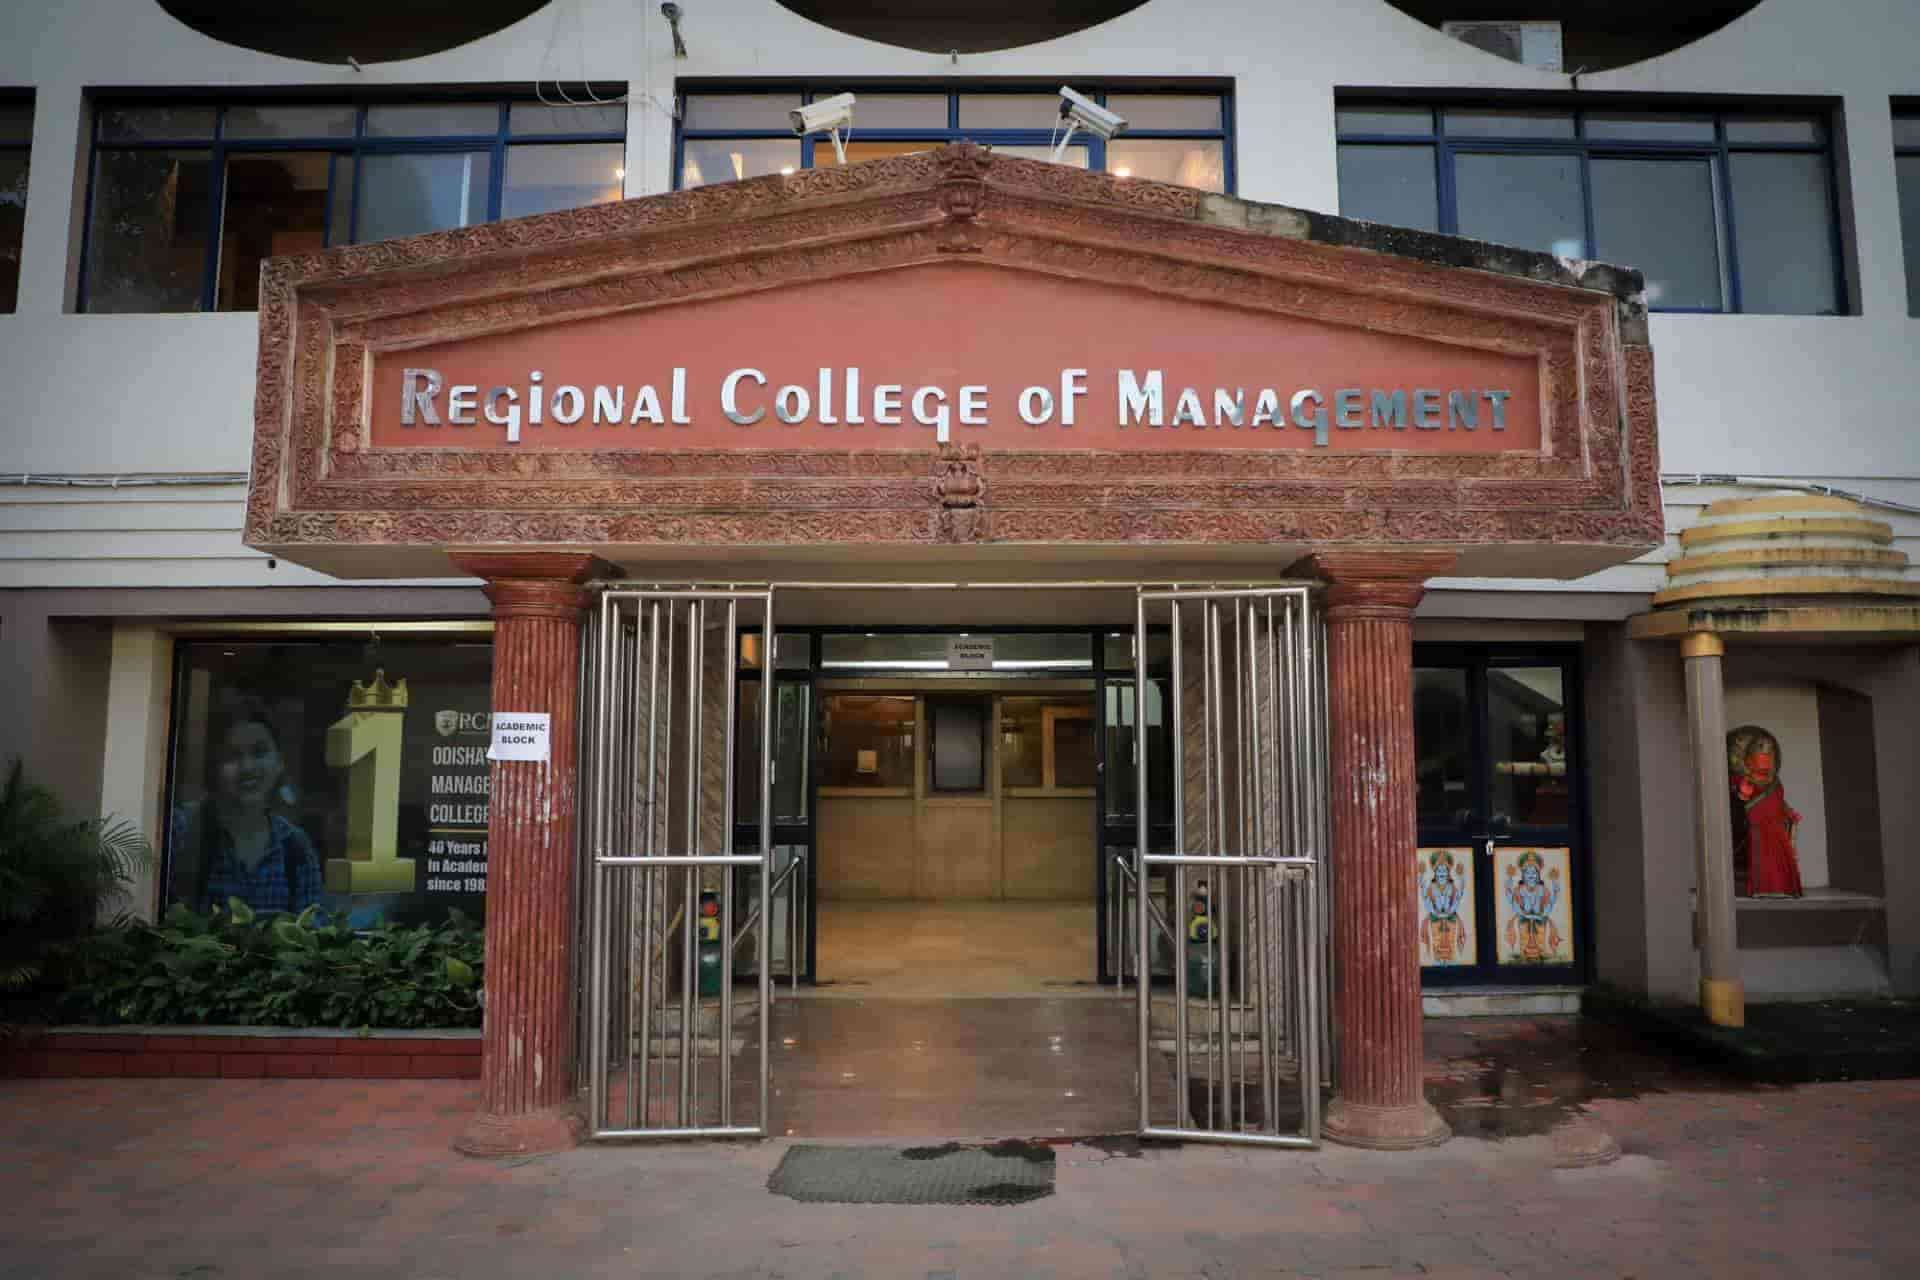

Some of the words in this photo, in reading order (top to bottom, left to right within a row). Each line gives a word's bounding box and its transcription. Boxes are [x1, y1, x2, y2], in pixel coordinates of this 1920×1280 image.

[459, 711, 491, 731] RC
[495, 722, 546, 732] ACADEMIC
[501, 735, 536, 745] BLOCK
[432, 745, 489, 767] ODISHA'
[431, 775, 489, 795] MANAGE
[447, 840, 481, 856] Years
[442, 859, 488, 874] Academ
[427, 876, 462, 891] since
[464, 878, 488, 892] 198
